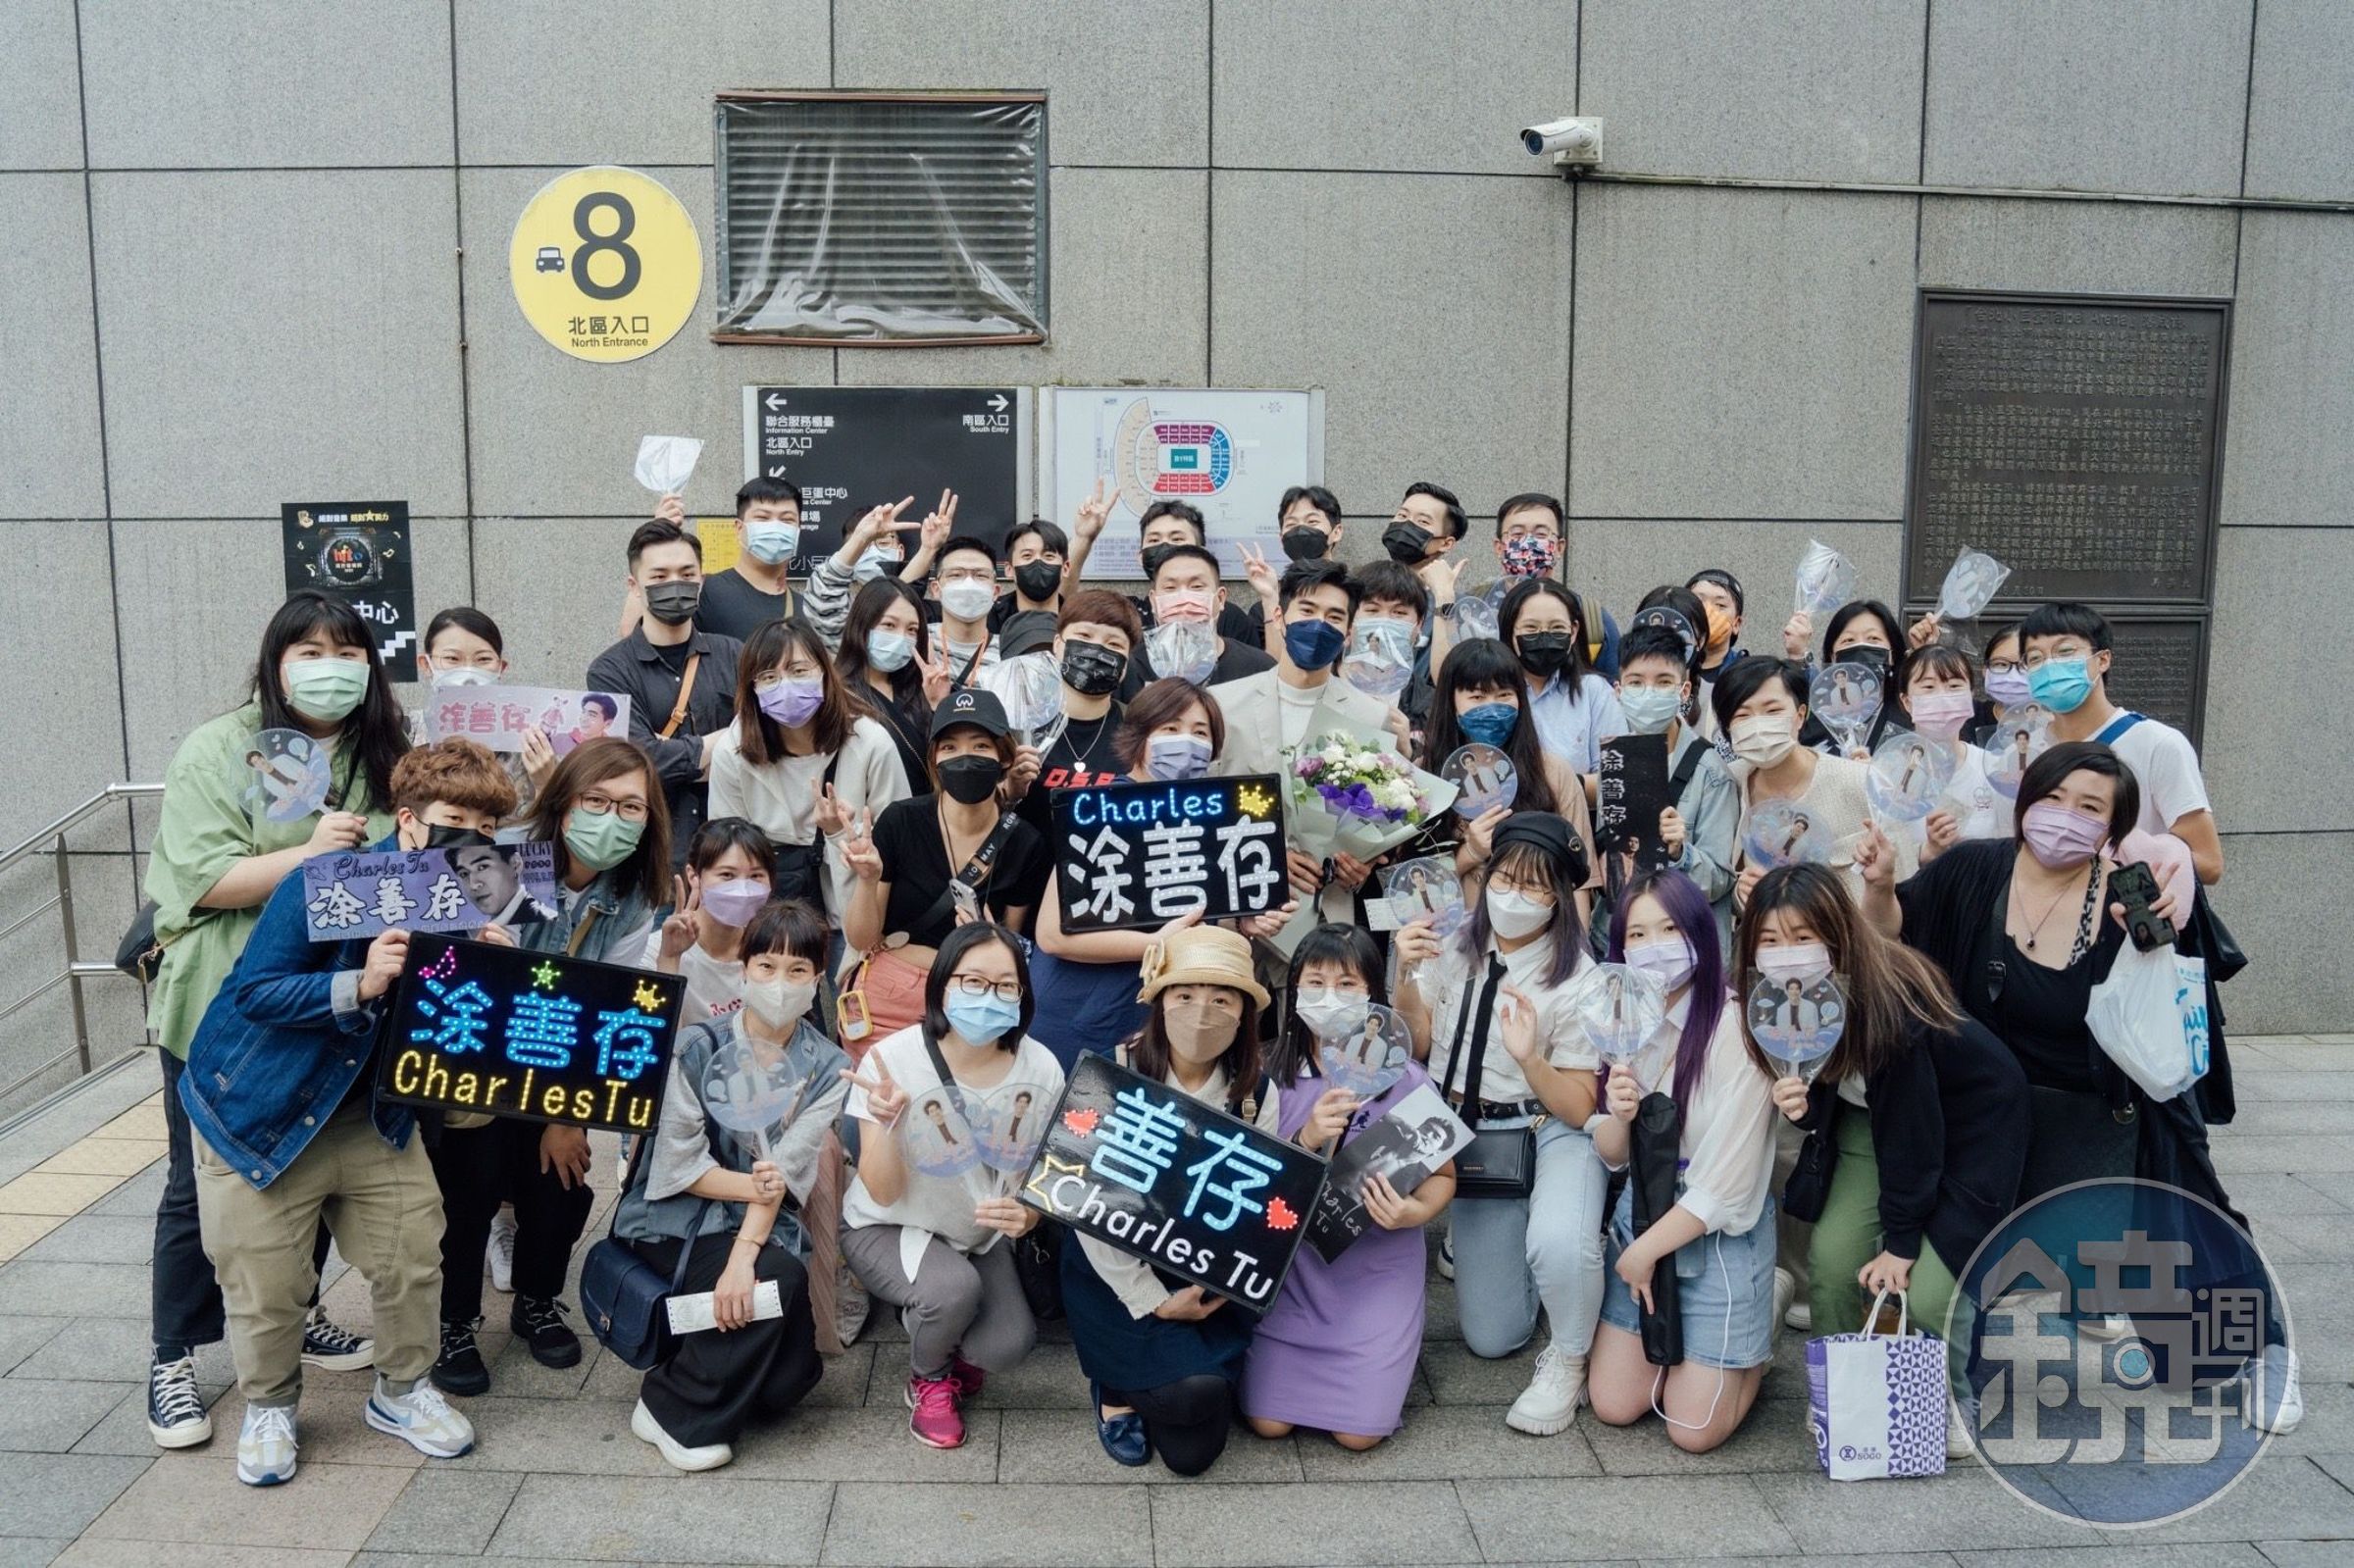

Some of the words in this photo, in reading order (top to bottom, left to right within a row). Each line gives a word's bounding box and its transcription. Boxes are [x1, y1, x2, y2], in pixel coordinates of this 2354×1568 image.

[571, 191, 641, 301] 8
[568, 316, 649, 335] 北區入口
[572, 337, 600, 347] North
[602, 335, 648, 347] Entrance
[962, 414, 1009, 427] 南區入口
[991, 426, 1010, 434] Entry
[765, 436, 813, 449] 北區入口
[799, 486, 848, 500] 巨蛋中心
[1073, 787, 1223, 825] Charles
[333, 853, 405, 881] Charles
[405, 851, 431, 874] Tu
[1067, 813, 1280, 924] 涂善存
[307, 872, 467, 930] 涂善存
[410, 979, 667, 1080] 涂善存
[1091, 1087, 1284, 1232] 善存
[1320, 1178, 1364, 1238] harles
[1049, 1175, 1216, 1275] Charles
[1226, 1250, 1274, 1300] Tu
